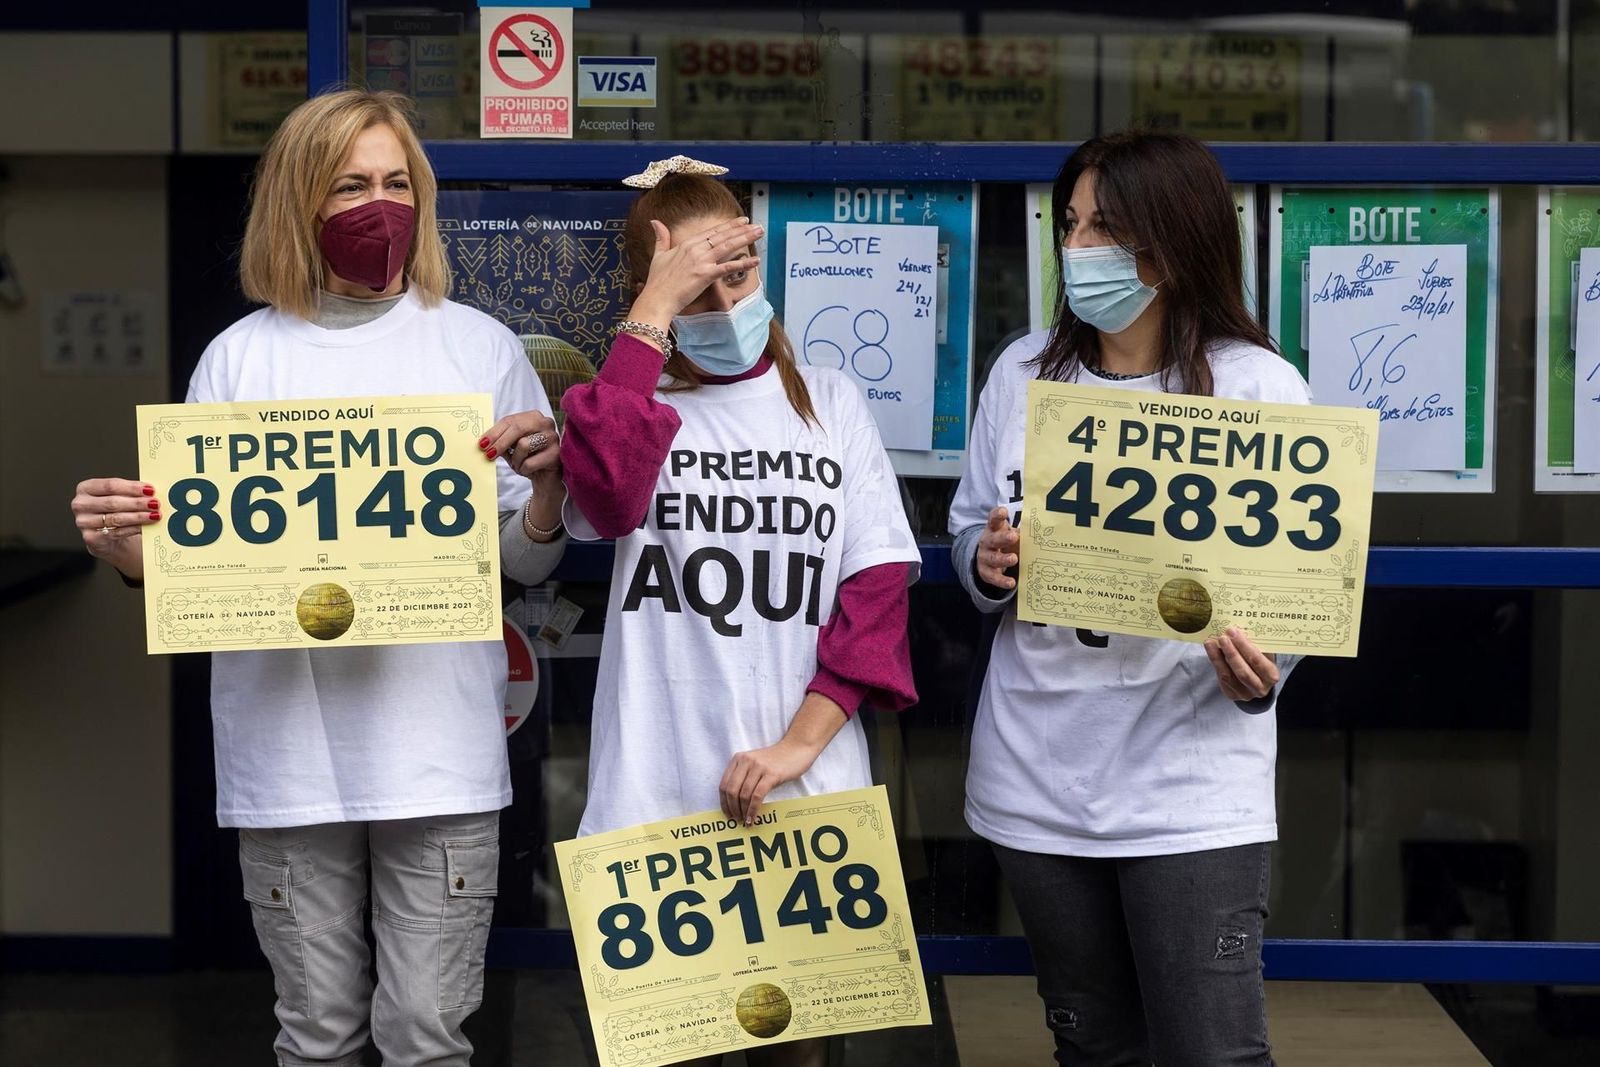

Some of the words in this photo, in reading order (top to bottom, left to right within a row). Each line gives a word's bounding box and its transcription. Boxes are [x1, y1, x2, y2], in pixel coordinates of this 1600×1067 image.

[677, 40, 818, 76] 38858
[588, 71, 647, 92] VISA
[1152, 61, 1285, 91] 14036
[716, 79, 813, 104] Premio
[947, 79, 1044, 104] Premio
[485, 98, 568, 111] PROHIBIDO
[500, 113, 553, 125] FUMAR
[579, 119, 629, 132] Accepted
[631, 120, 655, 131] here
[833, 187, 906, 223] BOTE
[463, 217, 519, 230] LOTERÍA
[543, 219, 602, 230] NAVIDAD
[1349, 206, 1421, 243] BOTE
[804, 225, 881, 254] BOTE
[790, 262, 873, 279] EUROMILLONES
[1356, 253, 1400, 280] BOTE
[914, 308, 929, 318] 21
[803, 305, 893, 382] 68
[1349, 323, 1417, 395] 8,6
[258, 409, 330, 423] VENDIDO
[335, 405, 374, 420] AQUÍ
[1138, 401, 1212, 421] VENDIDO
[1218, 408, 1260, 425] AQUÍ
[1402, 396, 1418, 420] de
[186, 434, 222, 474] 1er
[228, 426, 446, 473] PREMIO
[1117, 419, 1329, 475] PREMIO
[670, 448, 843, 490] PREMIO
[166, 468, 476, 548] 86148
[636, 492, 836, 544] ENDIDO
[1044, 461, 1342, 552] 42833
[1099, 546, 1120, 554] Toledo
[1165, 563, 1184, 571] LOTERÍA
[621, 543, 825, 637] AQUÍ
[1047, 584, 1083, 595] LOTERÍA
[1097, 590, 1136, 602] NAVIDAD
[177, 610, 214, 621] LOTERÍA
[236, 610, 276, 618] NAVIDAD
[403, 603, 450, 611] DICIEMBRE
[1232, 609, 1243, 617] 22
[1246, 610, 1257, 618] DE
[1260, 612, 1308, 621] DICIEMBRE
[670, 818, 738, 840] VENDIDO
[742, 810, 777, 828] QUÍ
[606, 857, 641, 898] 1er
[645, 824, 849, 891] PREMIO
[596, 863, 888, 971] 86148
[636, 982, 653, 990] Puerta
[663, 976, 682, 984] Toledo
[732, 969, 752, 977] LOTERÍA
[752, 965, 778, 974] NACIONAL
[836, 992, 879, 1003] DICIEMBRE
[881, 989, 900, 997] 2021
[624, 1028, 660, 1042] LOTERÍA
[679, 1016, 718, 1030] NAVIDAD
